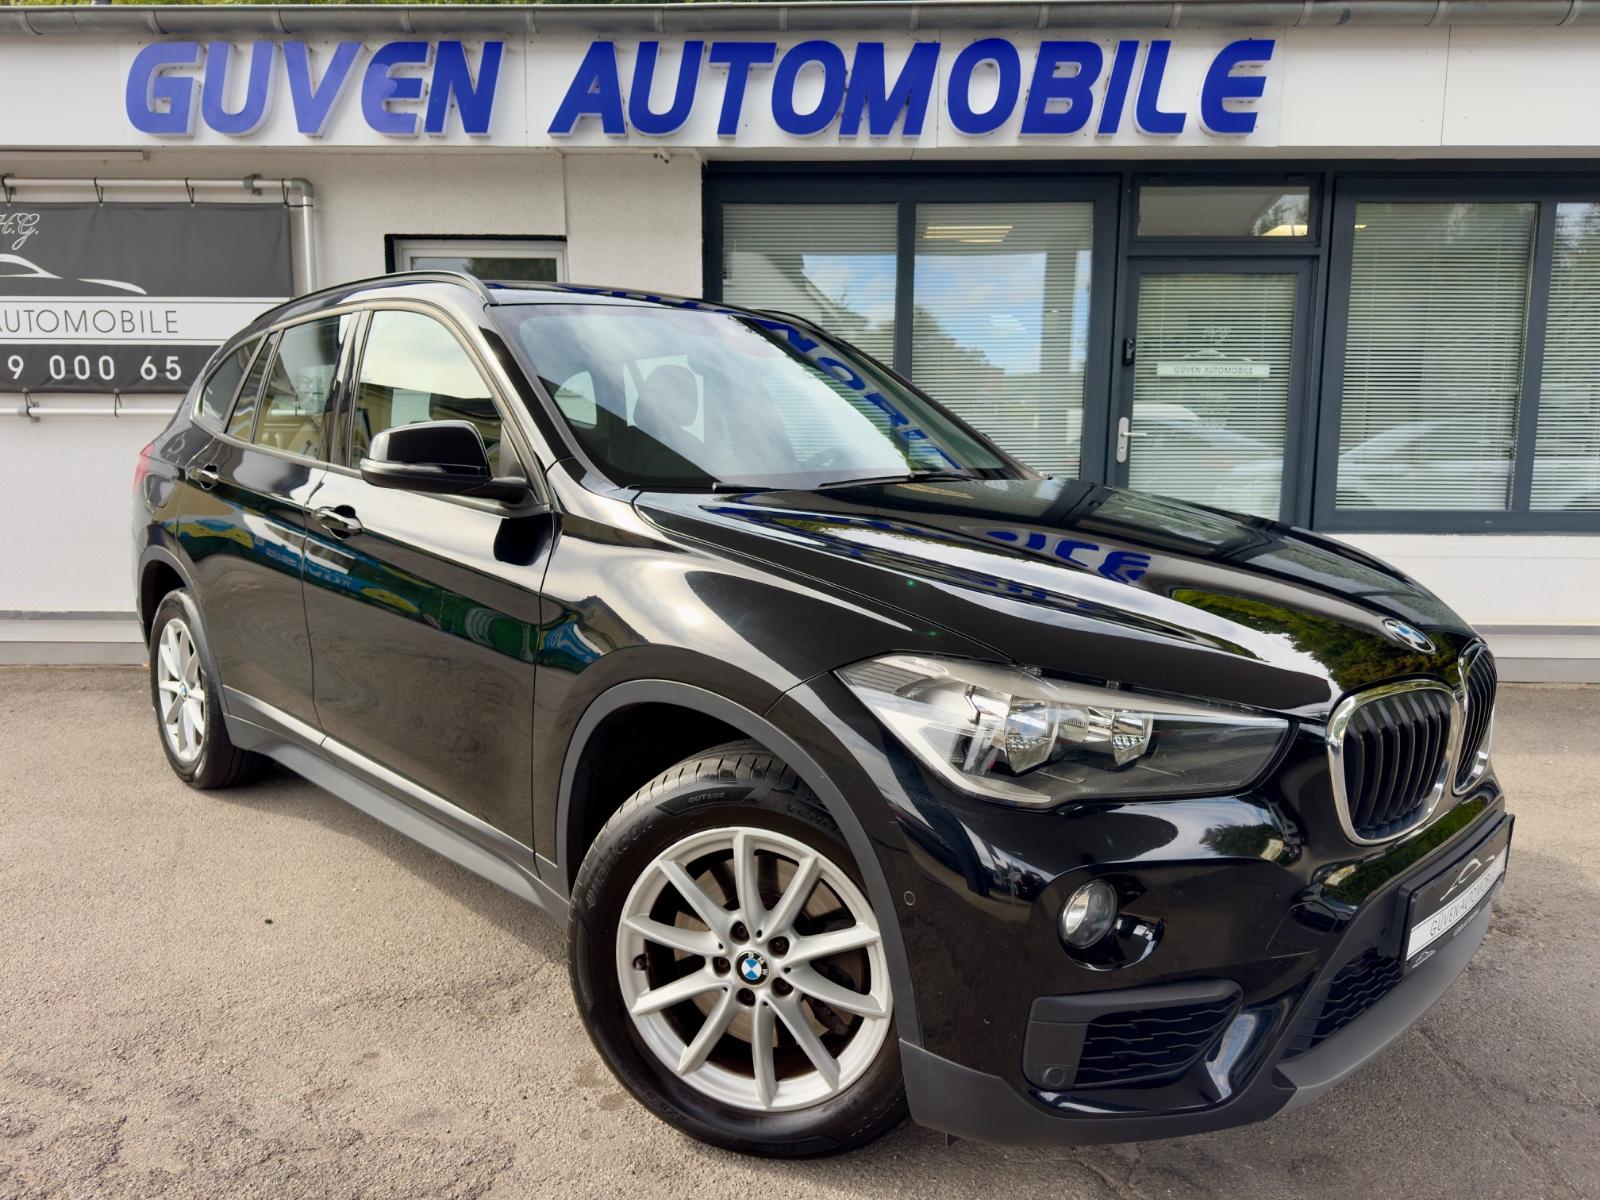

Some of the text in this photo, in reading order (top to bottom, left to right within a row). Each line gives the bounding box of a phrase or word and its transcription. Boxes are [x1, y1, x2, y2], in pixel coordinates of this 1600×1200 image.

[125, 38, 1276, 138] GUVEN AUTOMOBILE
[0, 309, 179, 334] UTOMOBILE
[49, 354, 116, 381] 000
[140, 355, 182, 381] 65
[1203, 366, 1254, 375] AUTOMOBILE
